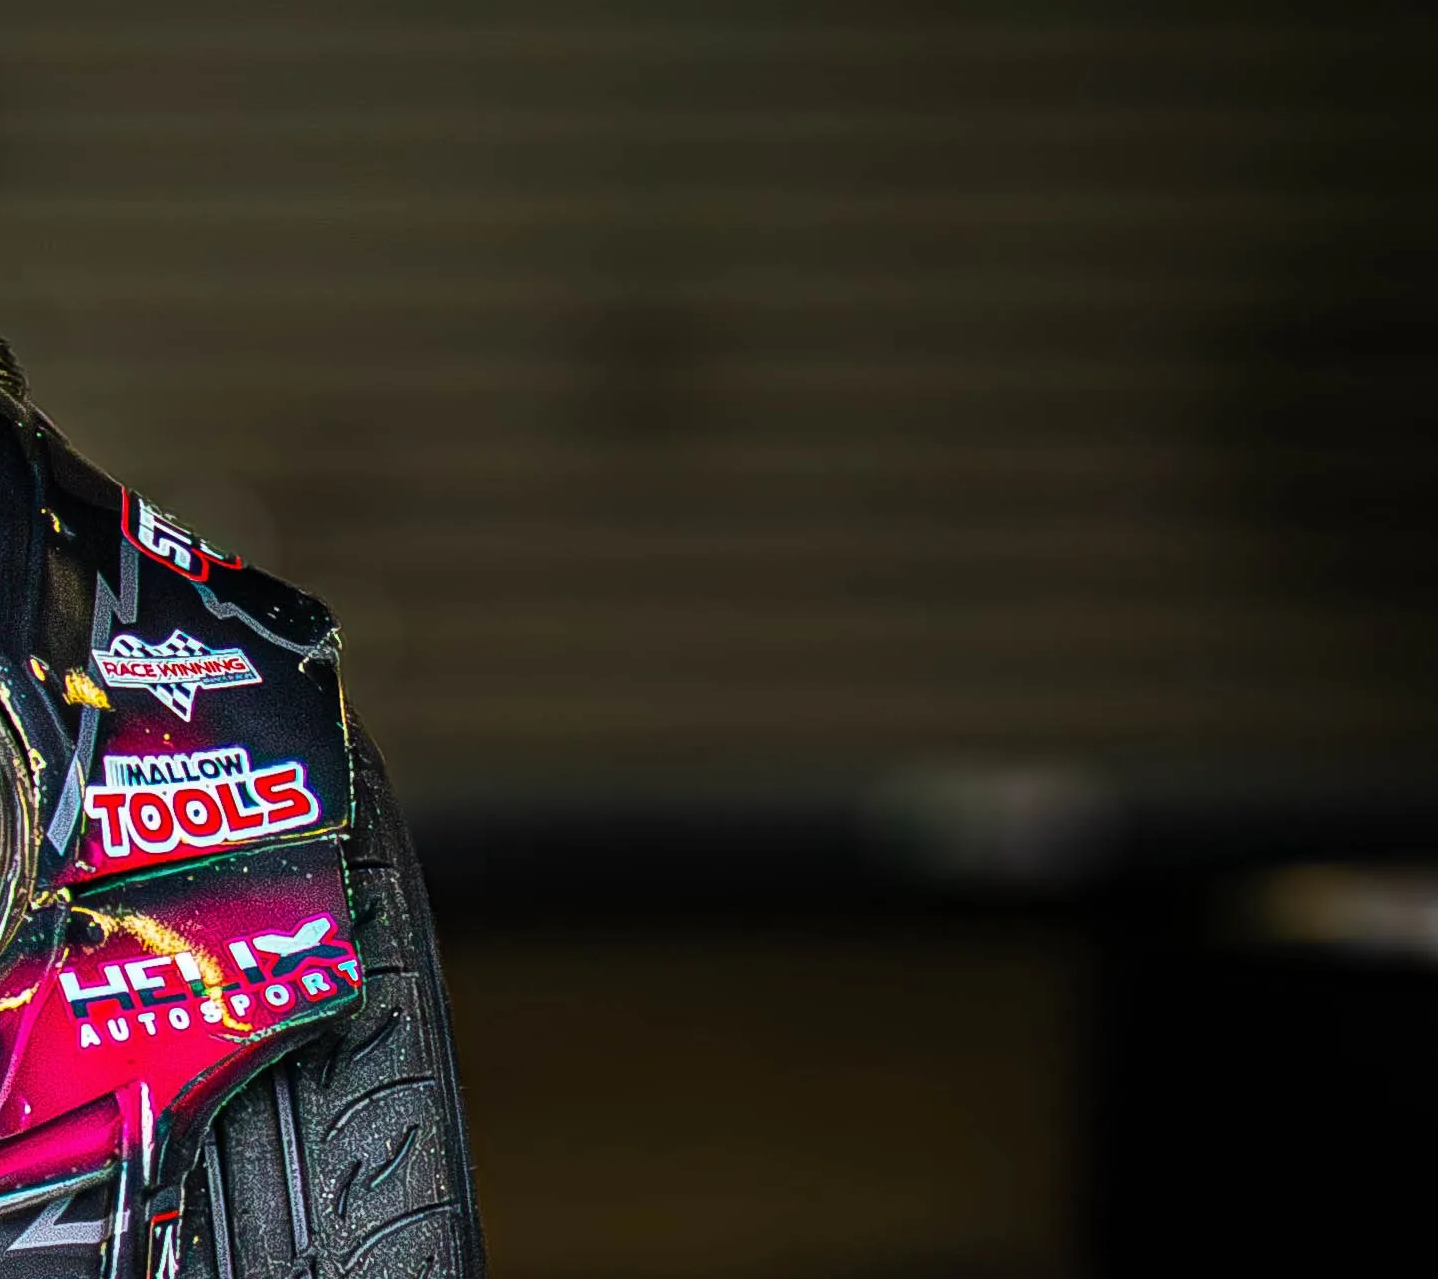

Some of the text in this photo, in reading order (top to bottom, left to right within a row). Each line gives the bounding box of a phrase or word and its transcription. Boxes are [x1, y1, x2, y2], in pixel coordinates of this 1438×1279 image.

[102, 658, 246, 678] RACE WINNING
[125, 752, 246, 787] MALLOW
[92, 769, 313, 845] TOOLS
[80, 959, 359, 1049] AUTOSPORT
